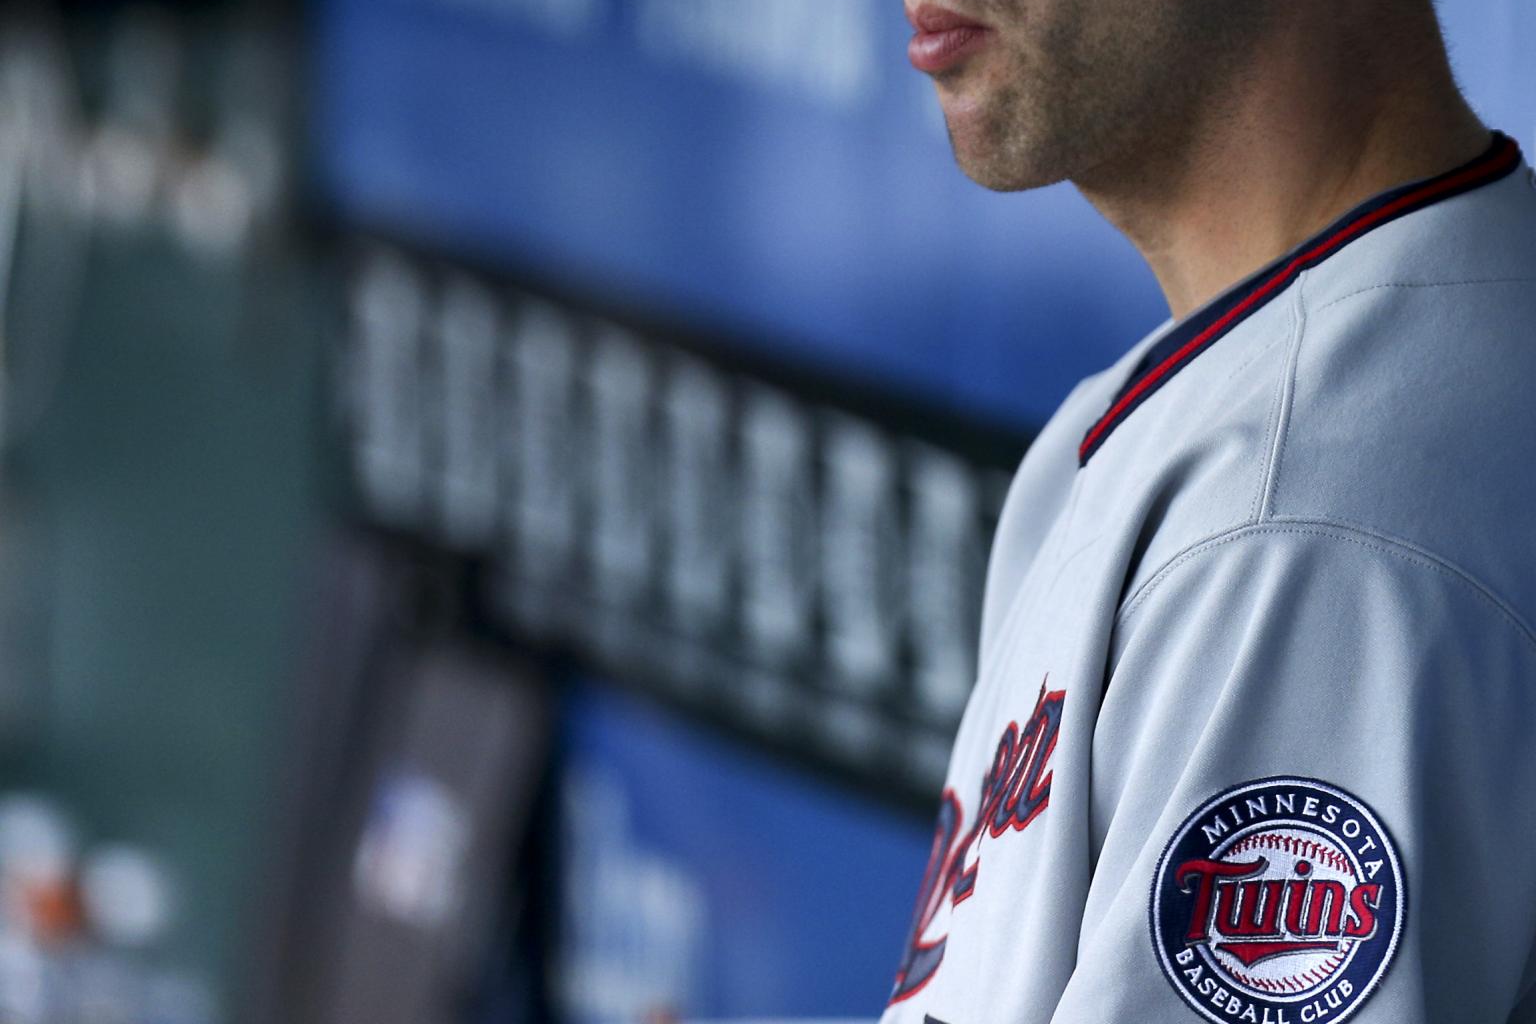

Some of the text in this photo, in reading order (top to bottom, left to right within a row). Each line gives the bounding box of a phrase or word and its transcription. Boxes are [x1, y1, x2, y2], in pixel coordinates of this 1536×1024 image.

[1201, 793, 1384, 879] MINNESOTA
[1174, 856, 1383, 947] Twins
[1175, 947, 1355, 1024] BASEBALL CLUB
